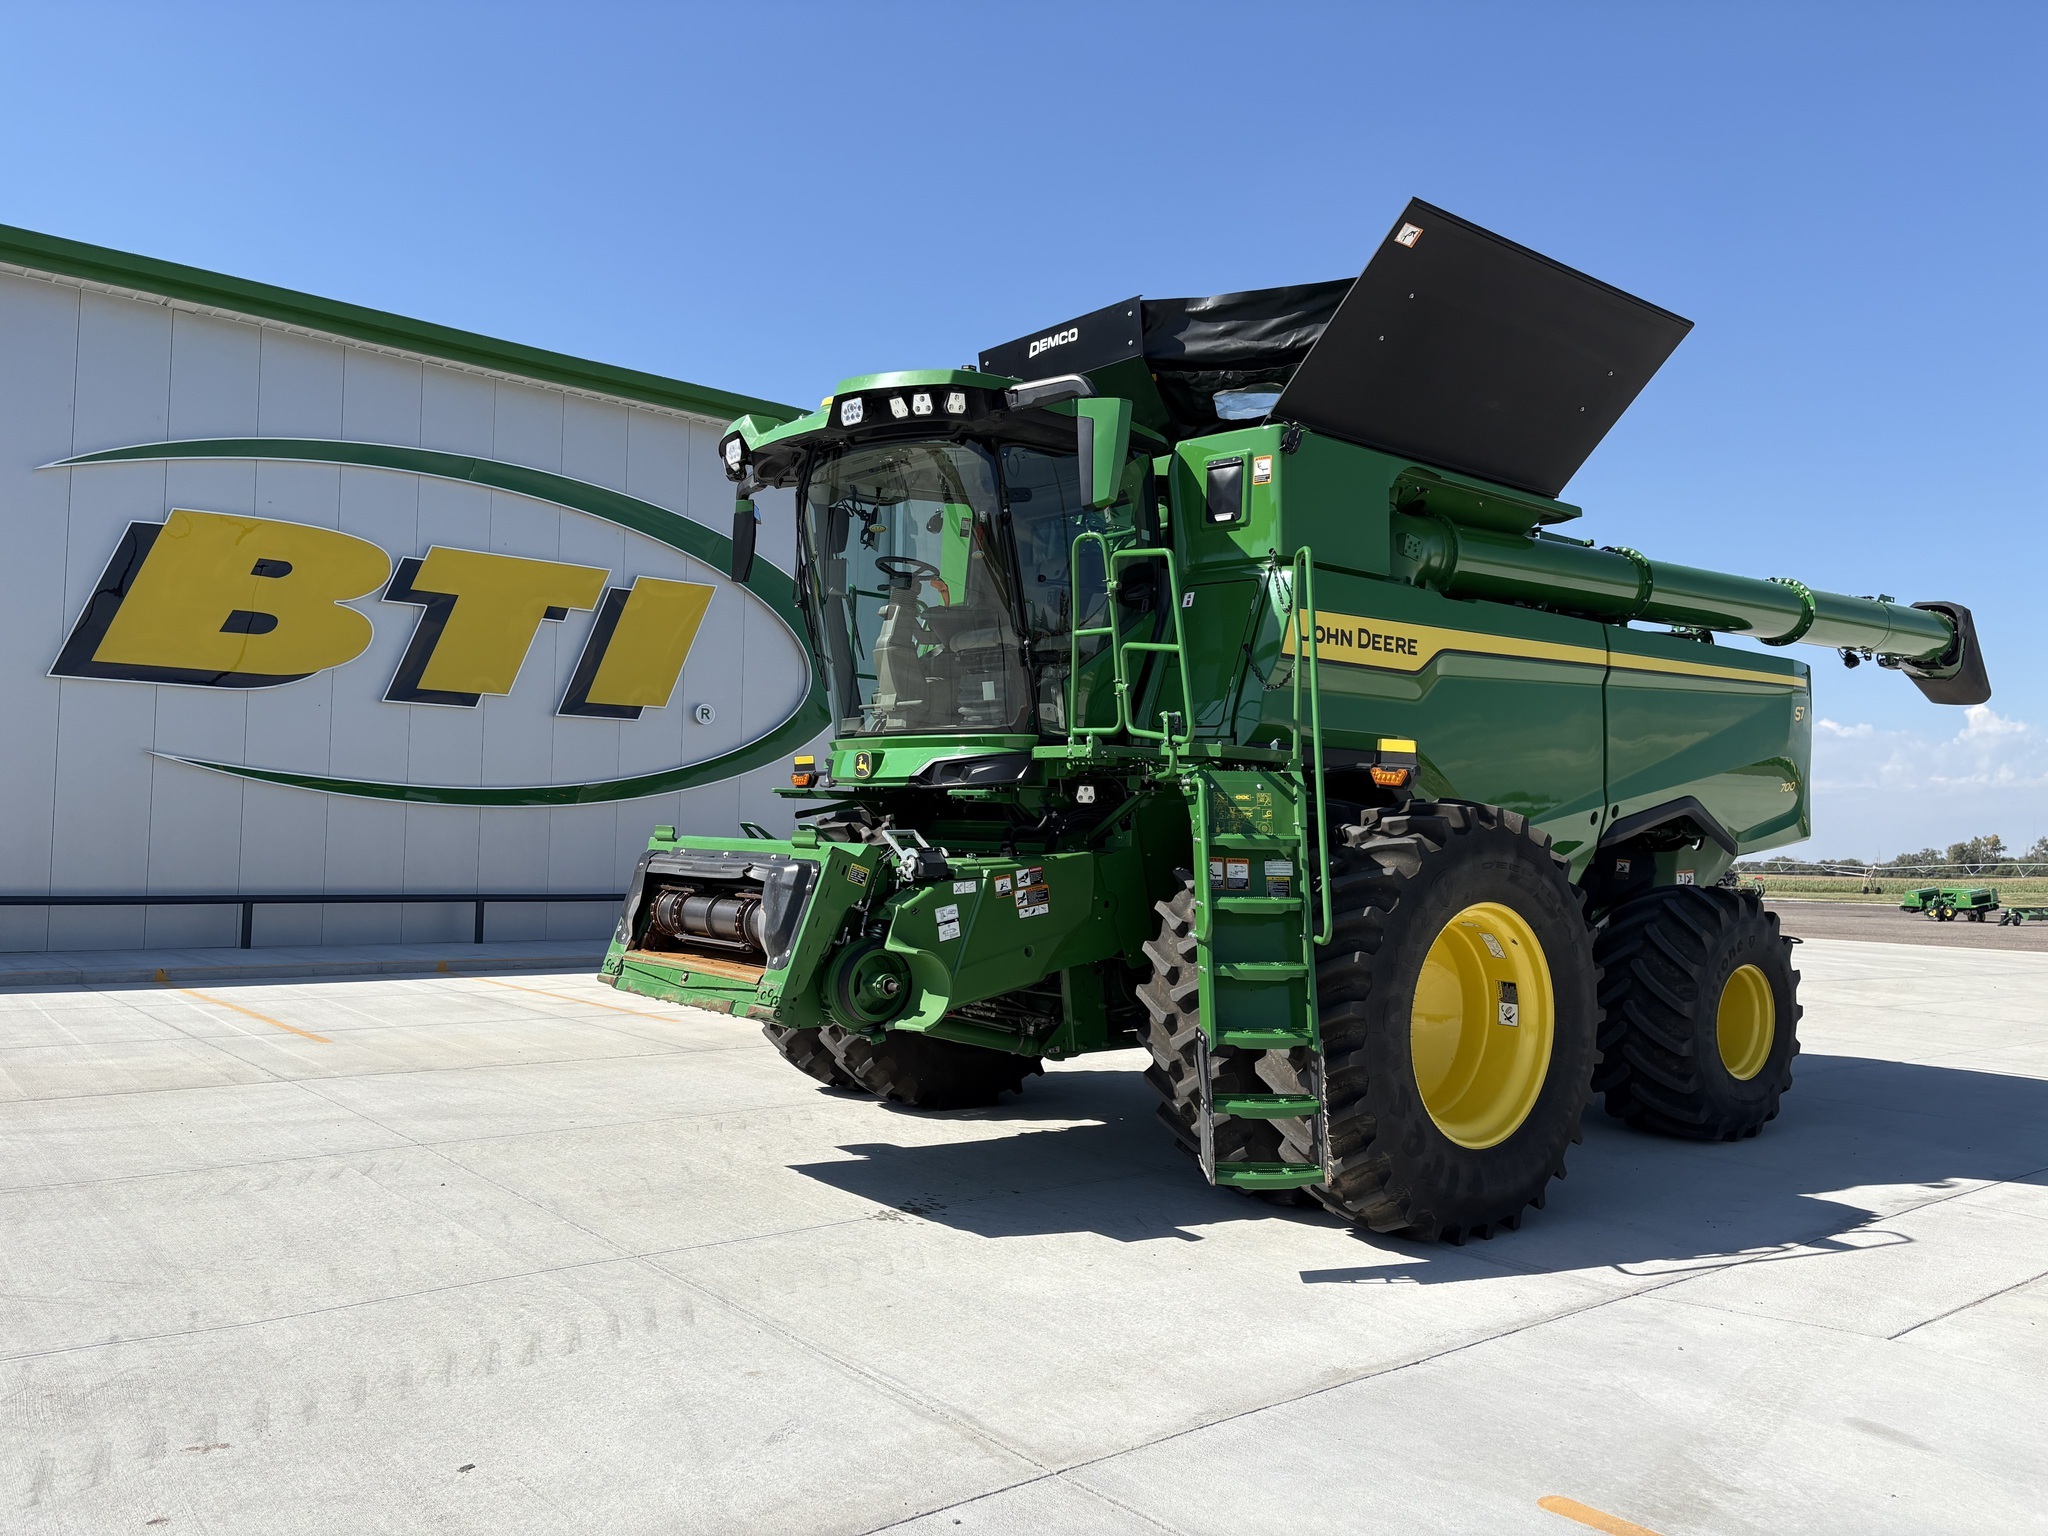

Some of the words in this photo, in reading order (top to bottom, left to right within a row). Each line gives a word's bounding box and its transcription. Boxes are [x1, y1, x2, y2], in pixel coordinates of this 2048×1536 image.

[1028, 327, 1079, 359] DEMCO
[47, 508, 716, 720] BTI
[1357, 627, 1418, 656] DEERE
[1795, 707, 1806, 722] S7
[1780, 782, 1796, 793] 700
